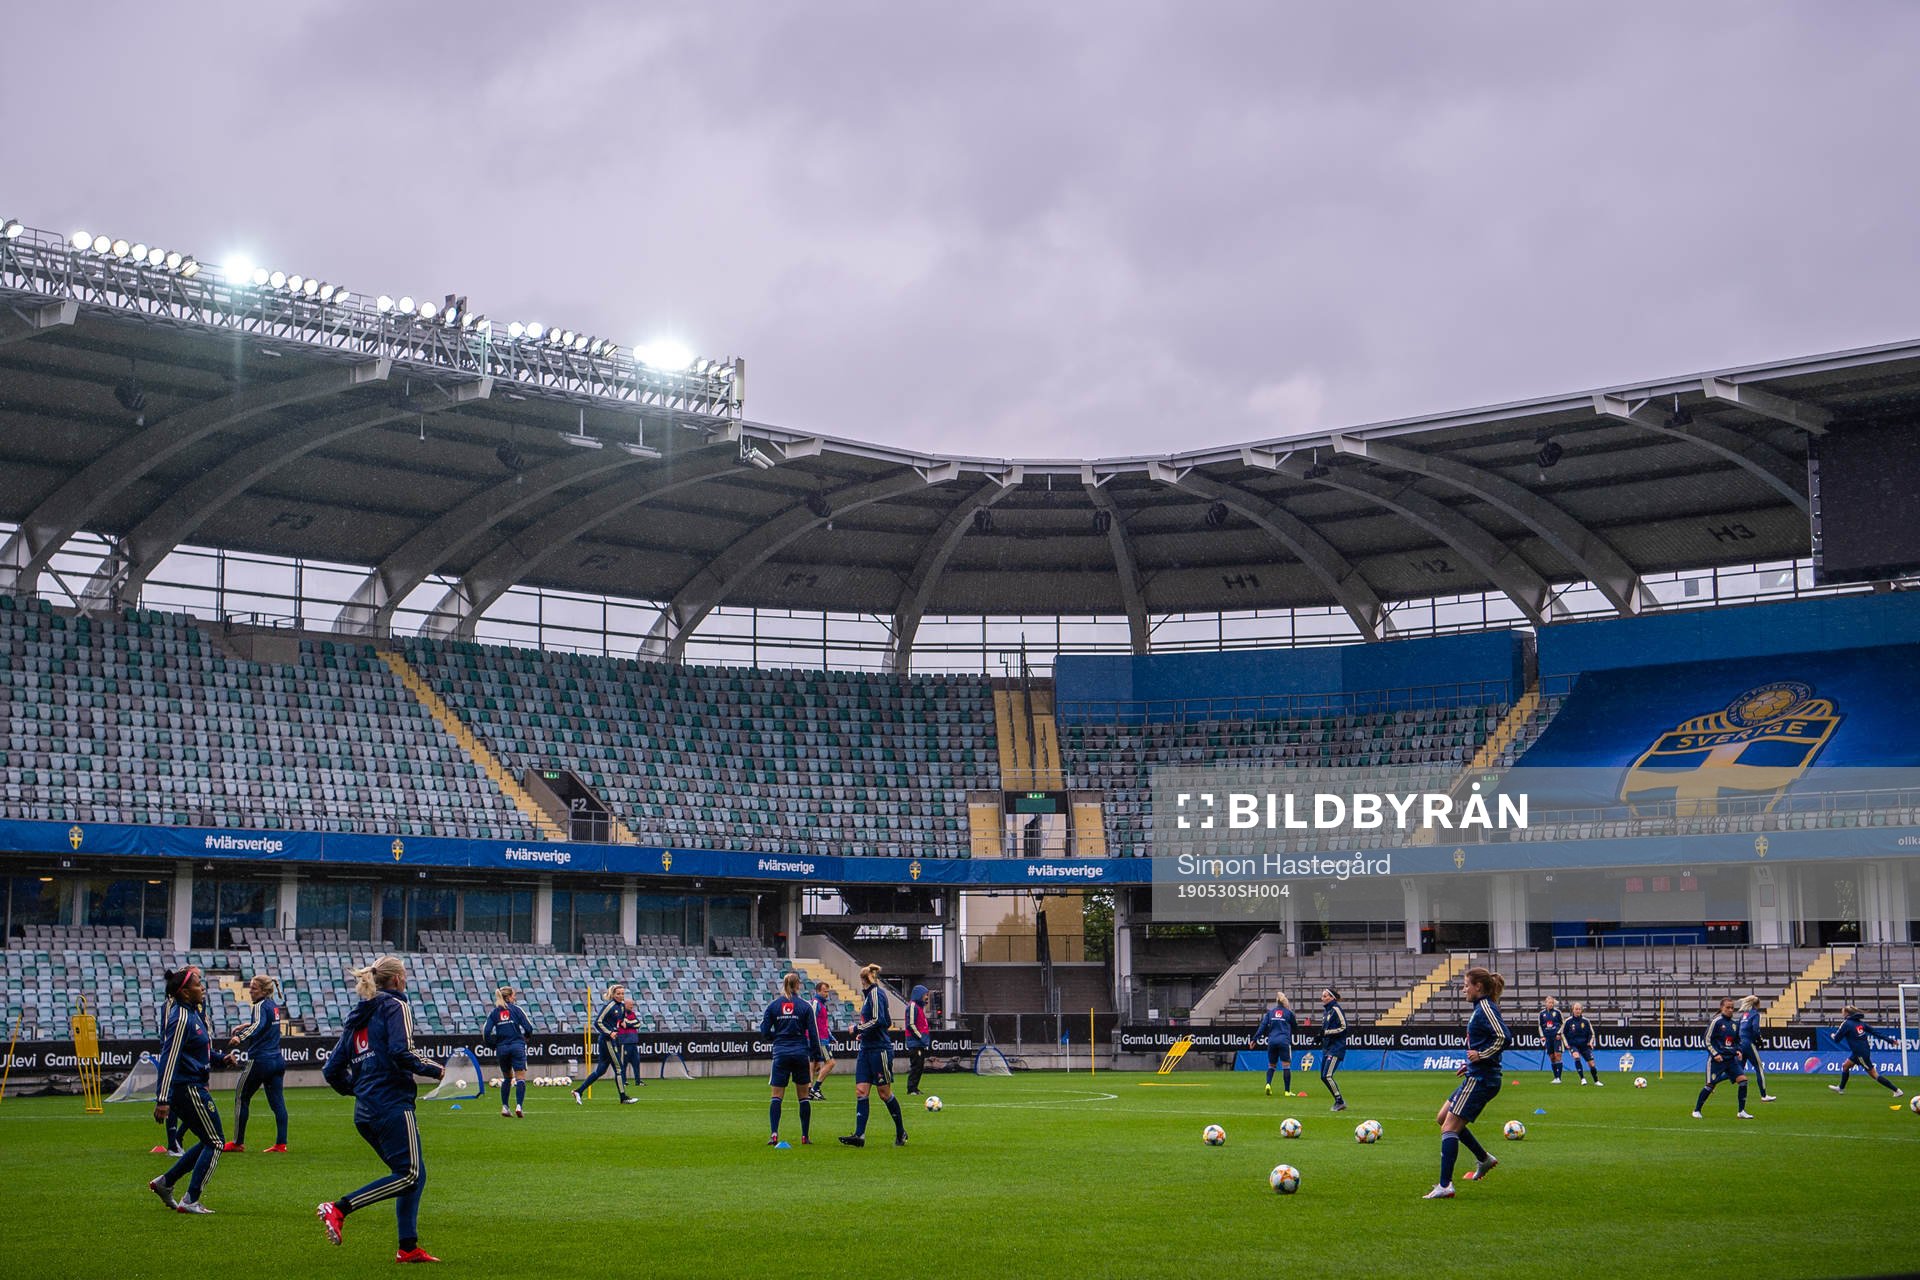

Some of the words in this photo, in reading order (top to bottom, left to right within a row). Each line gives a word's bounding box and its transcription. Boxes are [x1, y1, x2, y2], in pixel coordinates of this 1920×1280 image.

[1707, 524, 1756, 542] H3
[1222, 573, 1260, 589] H1
[1676, 721, 1808, 749] SVERIGE
[205, 835, 283, 854] #viärsverige
[505, 847, 572, 865] #viärsverige
[758, 859, 815, 875] #viärsverige
[1027, 865, 1103, 878] #viärsverige
[931, 1040, 958, 1050] Gamla
[1121, 1034, 1153, 1045] Gamla
[1189, 1034, 1220, 1045] Gamla
[1222, 1034, 1251, 1045] Ullevi
[1364, 1034, 1394, 1046] Ullevi
[1400, 1034, 1437, 1046] Gamla
[1438, 1034, 1468, 1046] Ullev
[1517, 1034, 1546, 1047] Ullev
[1598, 1034, 1633, 1047] Ullevi
[1640, 1035, 1681, 1048] Gamla
[1773, 1036, 1811, 1049] Ullevi
[548, 1043, 583, 1056] Gamla
[654, 1042, 683, 1054] Ullevi
[687, 1041, 720, 1053] Gamla
[721, 1041, 748, 1053] Ullevi
[1768, 1062, 1799, 1071] OLIKA
[1880, 1063, 1902, 1072] BRA
